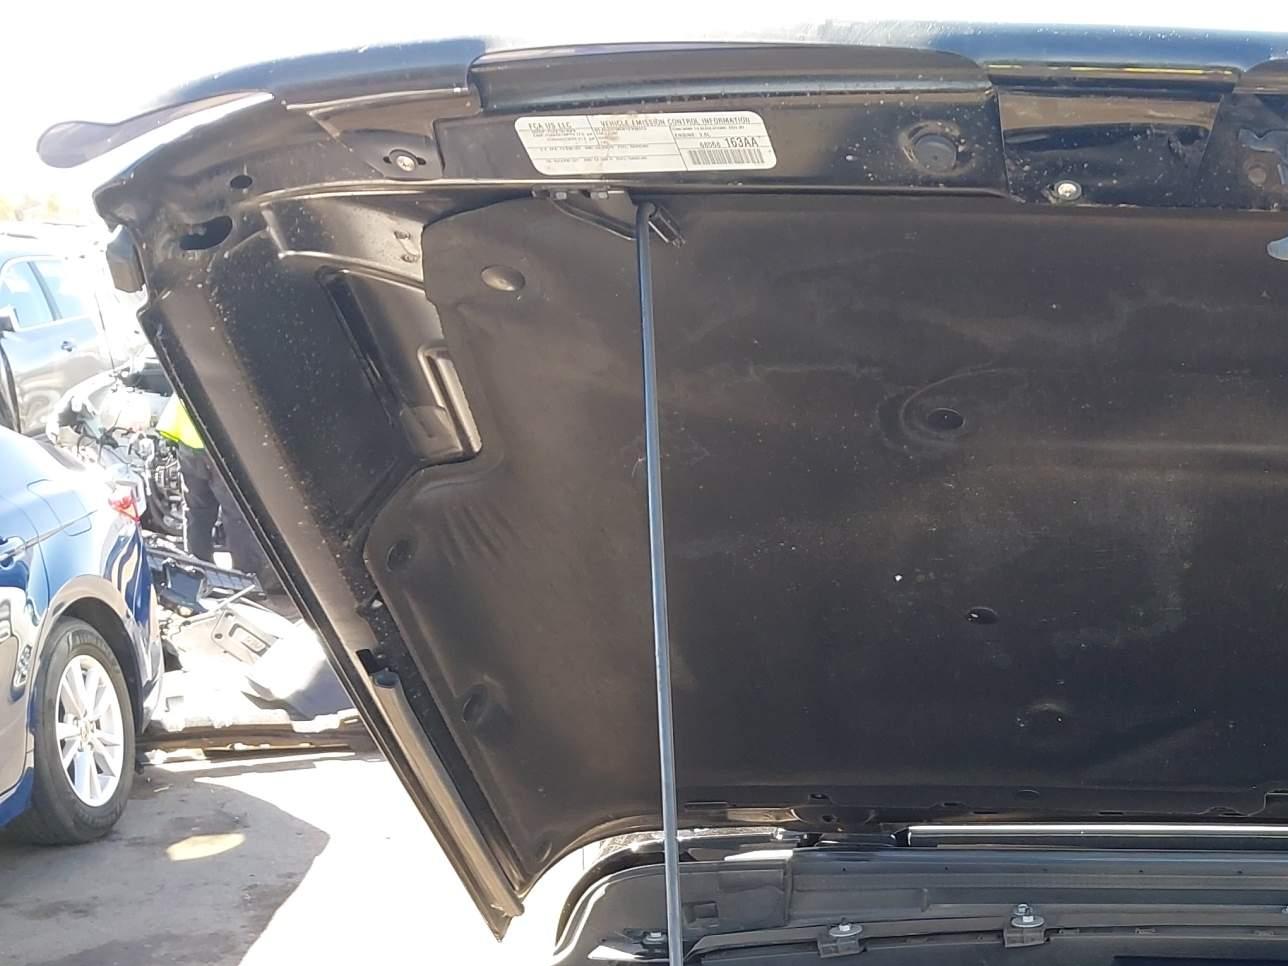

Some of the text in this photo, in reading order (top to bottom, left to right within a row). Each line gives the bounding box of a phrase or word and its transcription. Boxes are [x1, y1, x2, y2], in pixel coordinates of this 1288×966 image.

[600, 117, 750, 128] VEHICLE EMISSION CONTROL INFORMATION
[725, 137, 759, 148] 163AA
